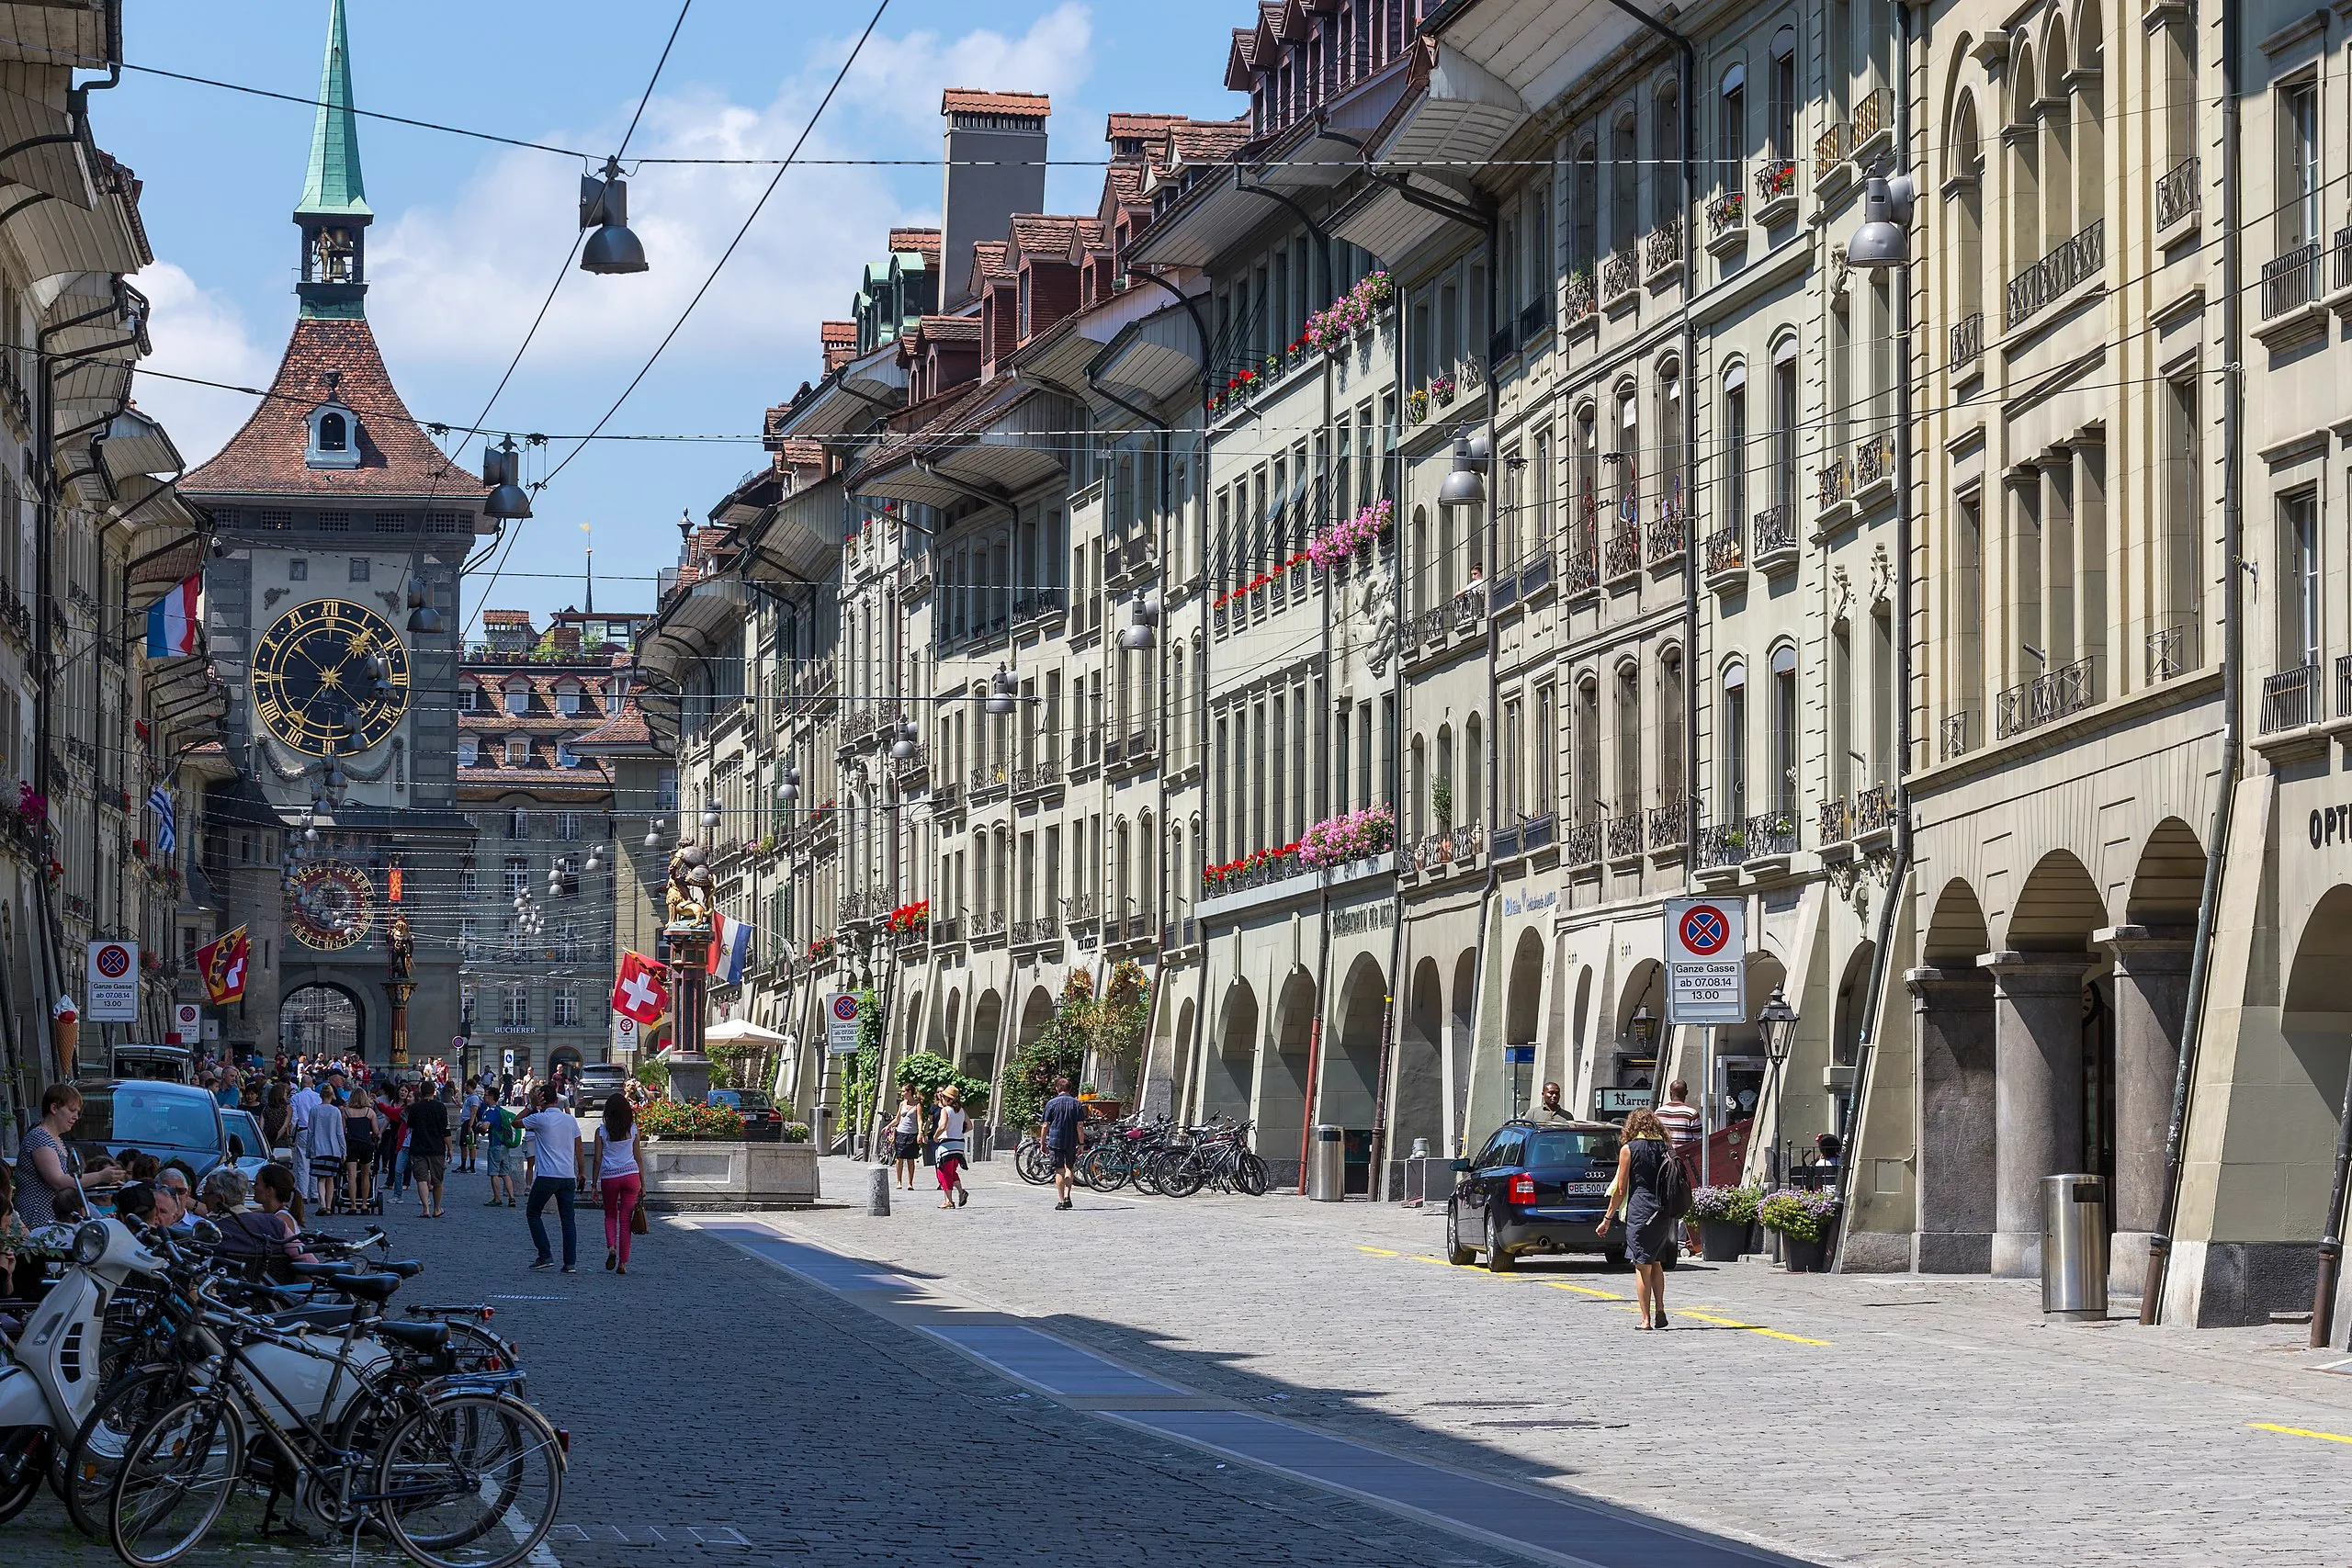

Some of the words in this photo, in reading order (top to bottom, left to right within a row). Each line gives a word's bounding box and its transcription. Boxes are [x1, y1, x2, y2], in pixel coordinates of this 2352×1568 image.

[1675, 964, 1704, 973] Ganze
[1706, 964, 1736, 973] Gasse
[1679, 978, 1692, 987] ab
[1694, 977, 1732, 987] 07.08.14
[1691, 990, 1720, 1000] 13.00
